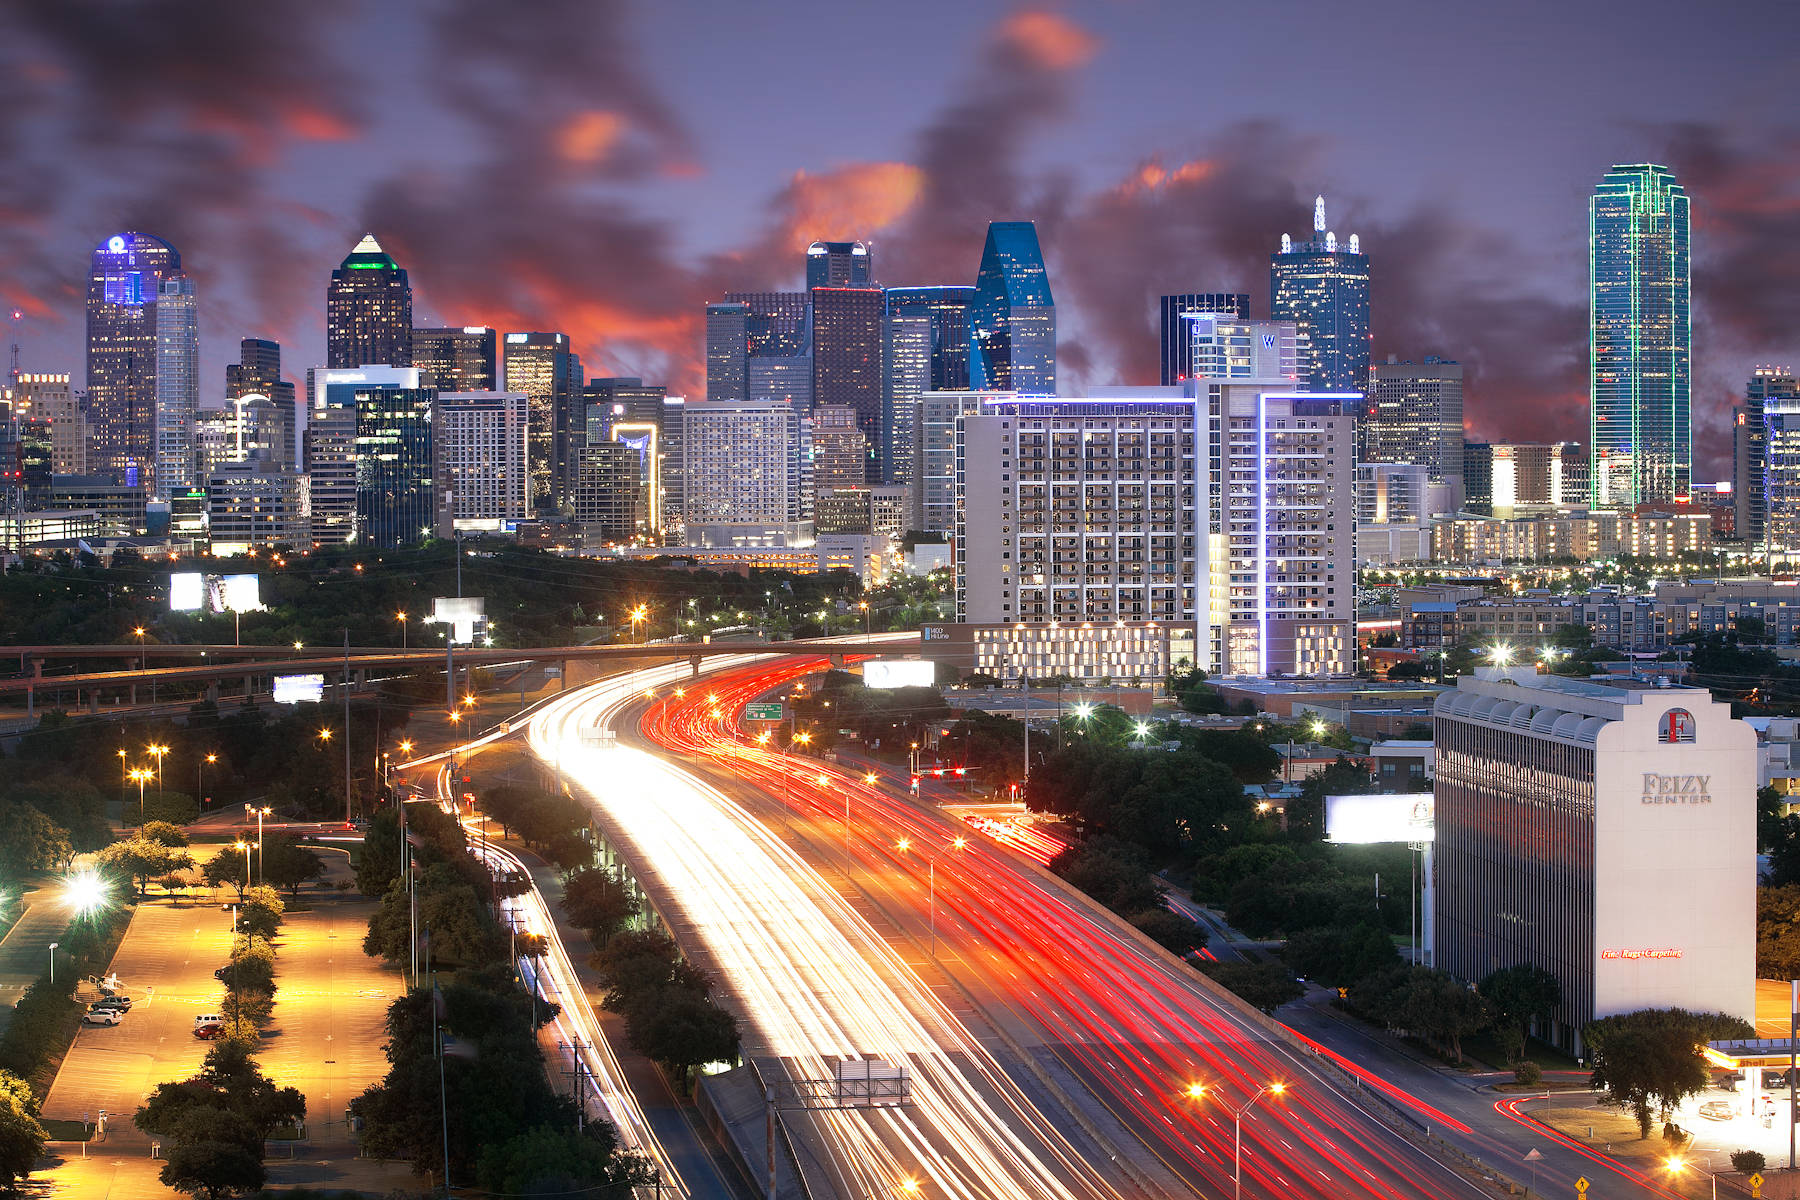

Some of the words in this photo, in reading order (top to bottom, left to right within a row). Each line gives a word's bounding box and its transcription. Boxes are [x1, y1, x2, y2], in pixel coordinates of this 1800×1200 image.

[1261, 334, 1275, 351] W
[1667, 712, 1689, 743] F
[1640, 772, 1712, 795] FEIZY
[1641, 795, 1712, 804] CENTER
[1739, 1059, 1765, 1068] Shell
